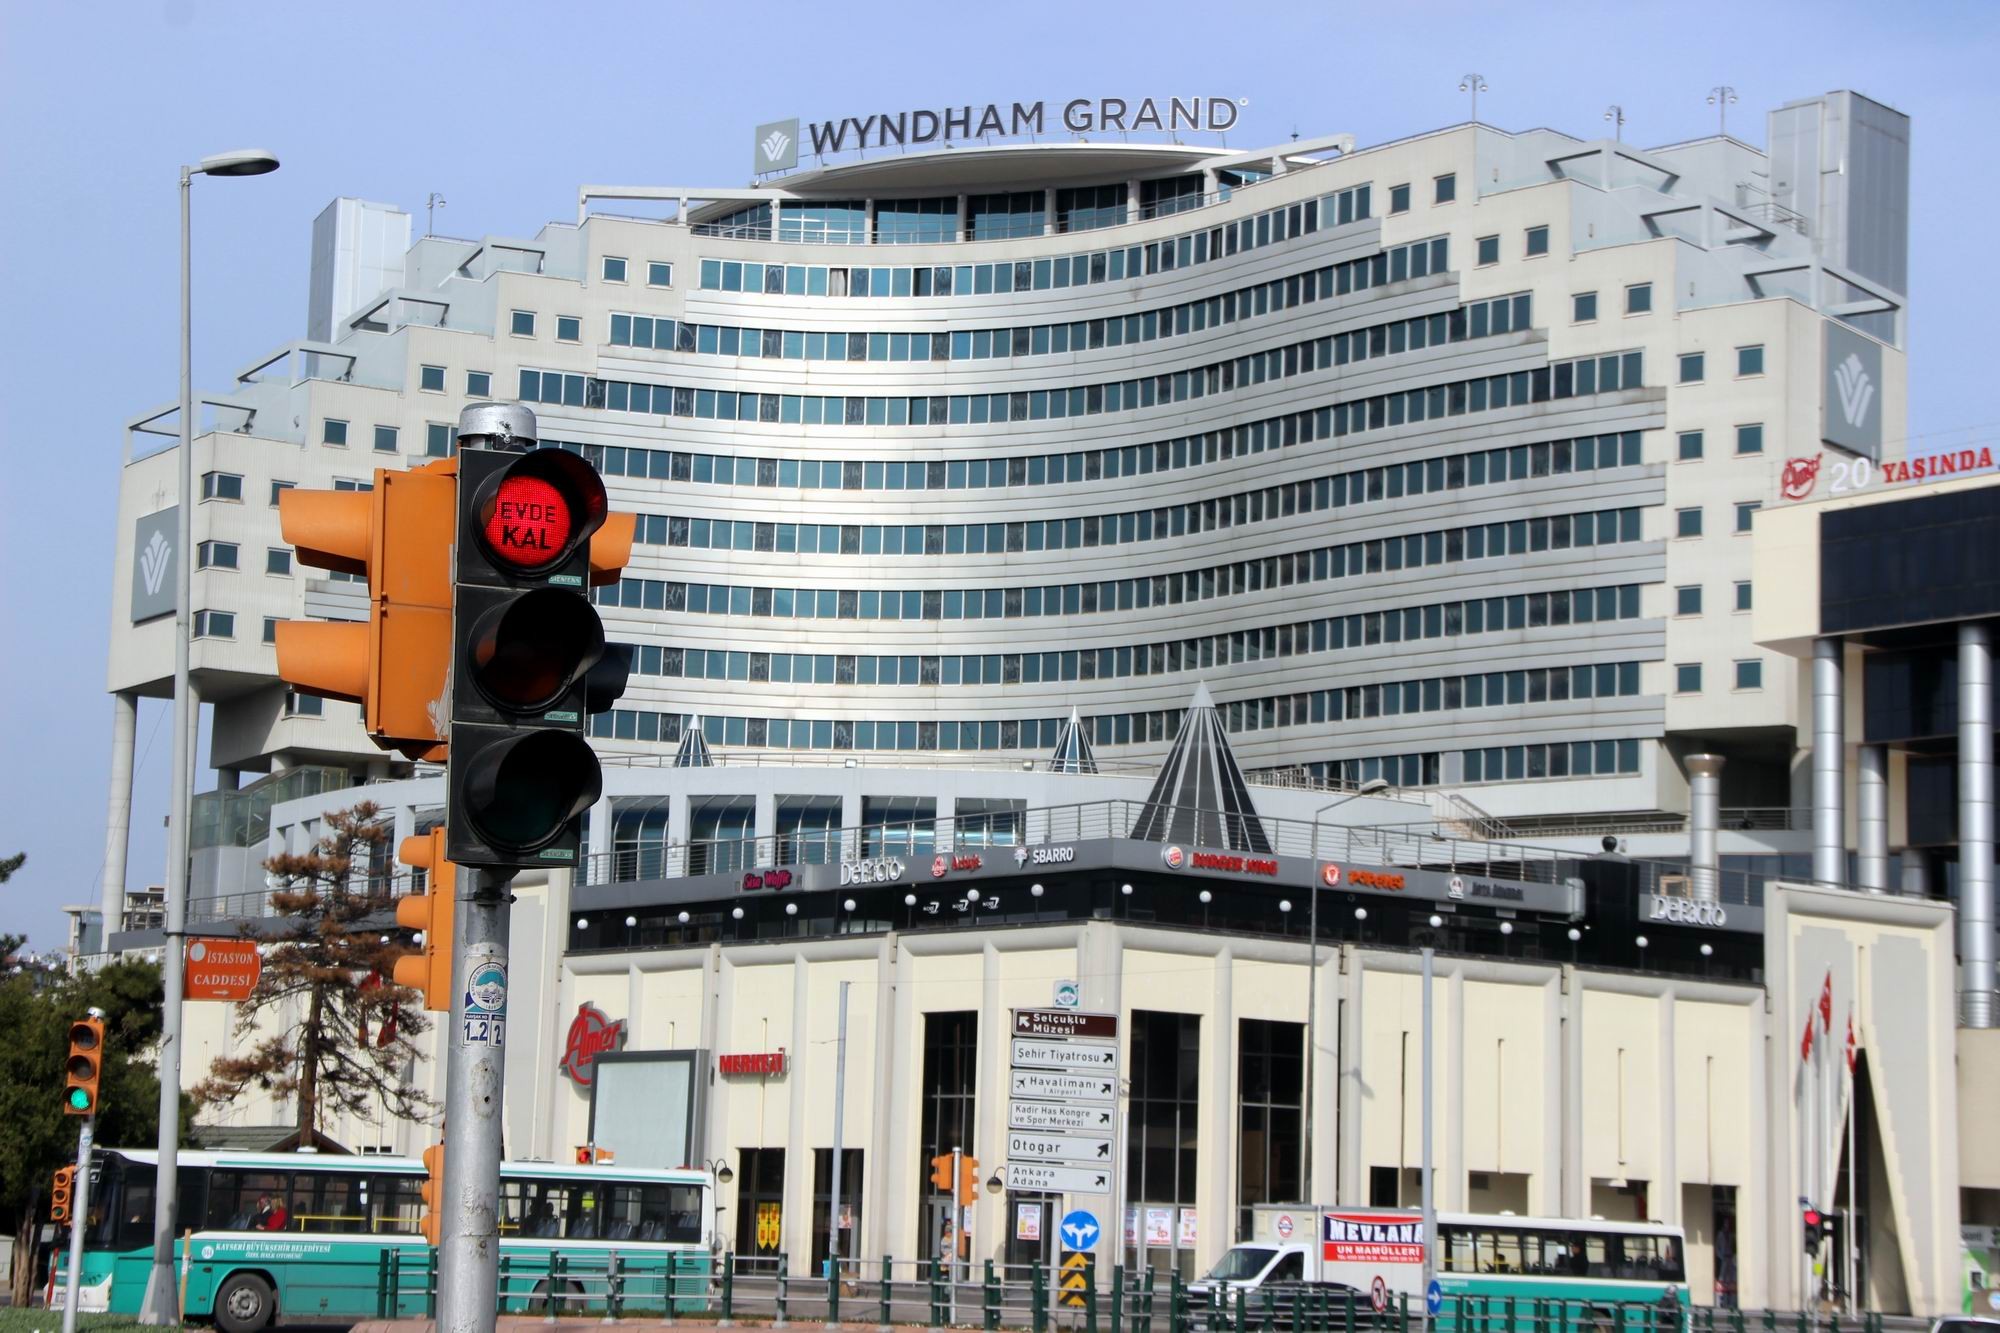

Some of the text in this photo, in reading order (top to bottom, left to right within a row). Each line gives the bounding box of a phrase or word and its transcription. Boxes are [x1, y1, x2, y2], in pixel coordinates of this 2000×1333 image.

[809, 96, 1238, 155] WYNDHAM GRAND
[1829, 457, 1870, 492] 20
[501, 501, 556, 523] EVDE
[502, 525, 552, 549] KAL
[1033, 847, 1073, 864] SBARRO
[207, 951, 254, 964] İSTASYON
[193, 974, 251, 986] CADDESİ
[1033, 1013, 1087, 1026] Selçuklu
[1033, 1023, 1075, 1035] Müzesi
[719, 1047, 787, 1074] MERKEZİ
[1050, 1049, 1100, 1063] Tiyatrosu
[1030, 1076, 1097, 1089] Havalimanı
[1015, 1104, 1091, 1118] Kadir Has Kongre
[1014, 1115, 1084, 1127] ve Spor Merkezi
[1012, 1138, 1061, 1155] Otogar
[1013, 1166, 1055, 1178] Ankara
[1013, 1176, 1048, 1187] Adana
[1330, 1219, 1423, 1244] MEVLANA
[215, 1241, 331, 1253] KAYSERİ BÜYÜKŞEHİR BELEDİYESİ
[1337, 1246, 1420, 1256] UN MAMÜLLERİ
